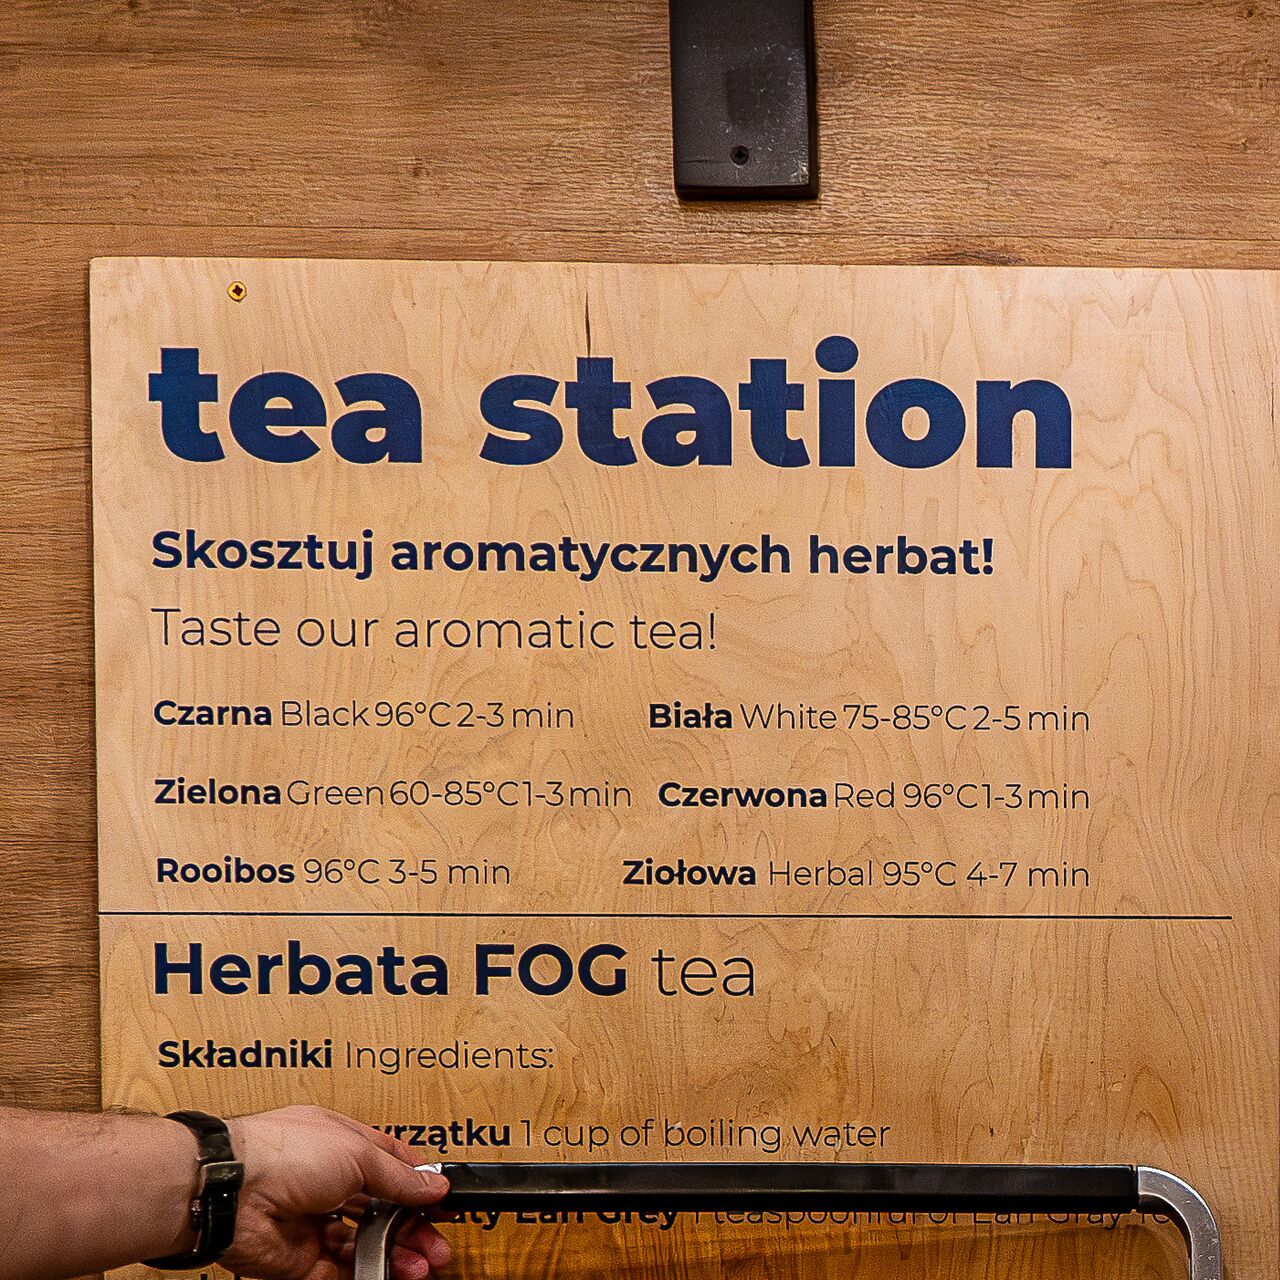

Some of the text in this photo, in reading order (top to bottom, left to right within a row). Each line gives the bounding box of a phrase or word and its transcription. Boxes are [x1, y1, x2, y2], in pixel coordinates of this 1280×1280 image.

[149, 336, 1071, 468] tea station
[153, 530, 992, 582] Skosztuj aromatycznych herbat!
[151, 609, 714, 649] Taste our aromatic tea!
[155, 701, 271, 725] Czarna
[282, 700, 369, 726] Black
[513, 702, 573, 727] min
[650, 702, 731, 728] Biała
[740, 703, 836, 729] White
[1029, 706, 1089, 730] min
[155, 777, 280, 804] Zielona
[288, 780, 383, 805] Green
[571, 782, 630, 806] min
[659, 783, 826, 807] Czerwona
[836, 782, 894, 807] Red
[1029, 784, 1088, 808] min
[158, 856, 294, 883] Rooibos
[389, 860, 437, 884] 3-5
[449, 859, 509, 884] min
[624, 858, 755, 885] Ziołowa
[770, 860, 872, 885] Herbal
[967, 862, 1017, 886] 4-7
[1029, 862, 1088, 886] min
[155, 941, 753, 996] Herbata FOG tea
[159, 1039, 553, 1075] Składniki Ingredients:
[521, 1120, 530, 1146] 1
[544, 1126, 609, 1152] cup
[621, 1119, 654, 1146] of
[665, 1119, 780, 1153] boiling
[793, 1123, 890, 1146] water
